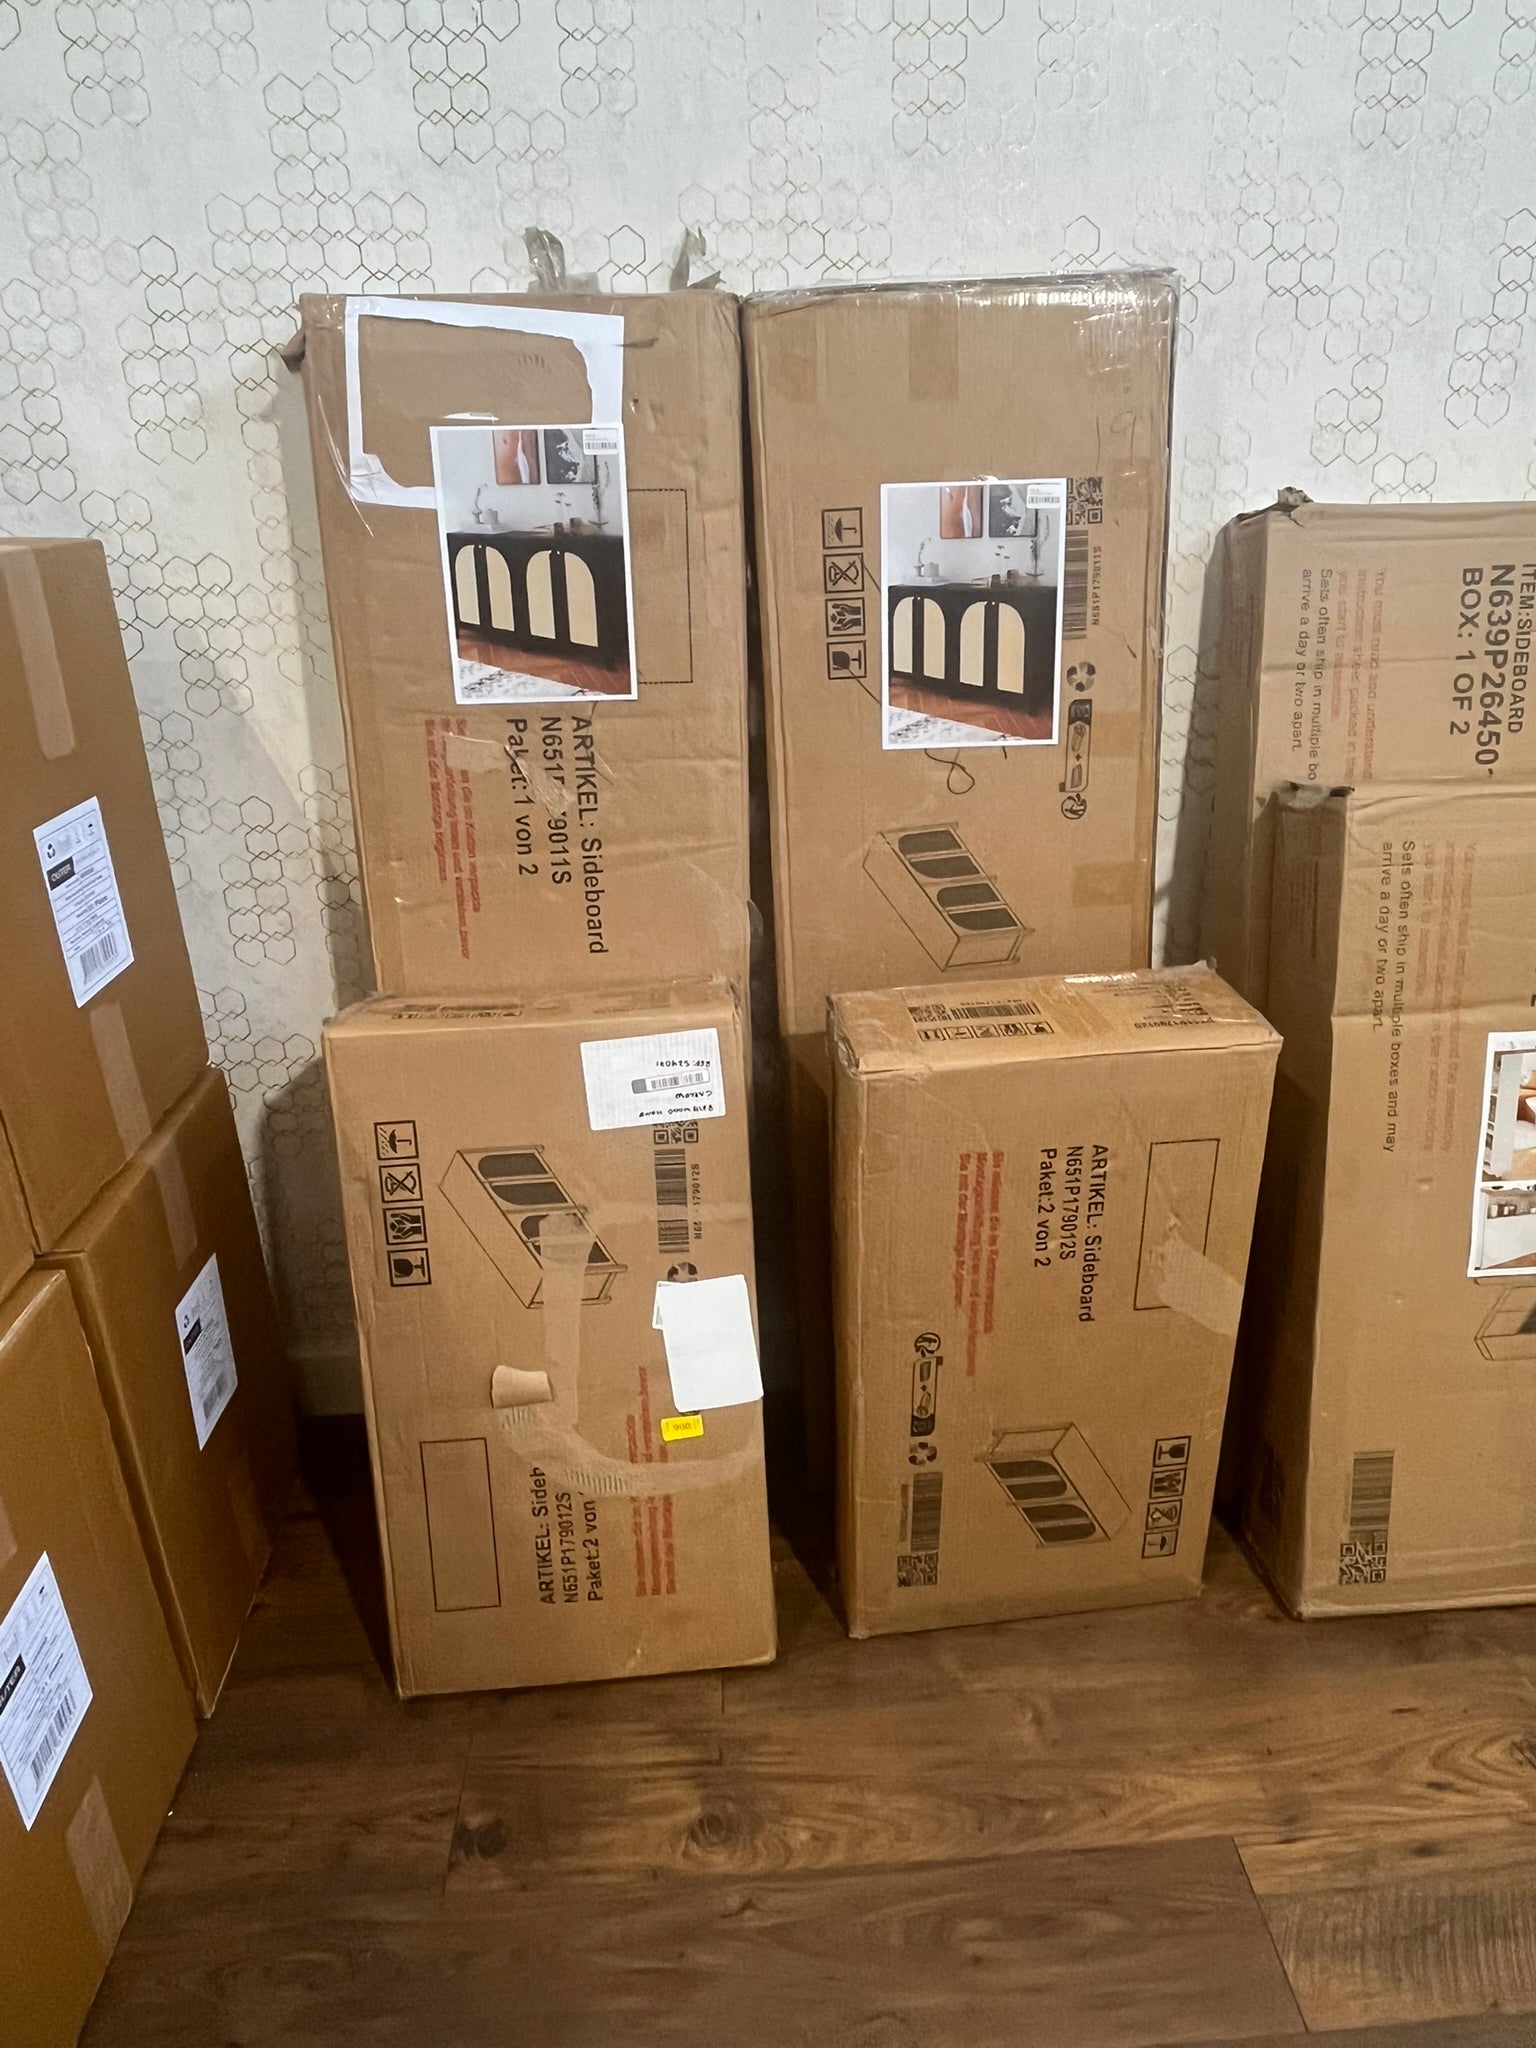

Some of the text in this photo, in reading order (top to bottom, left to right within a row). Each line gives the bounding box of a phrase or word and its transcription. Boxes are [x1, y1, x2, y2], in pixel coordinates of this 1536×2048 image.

[1301, 569, 1313, 611] arrive
[1299, 617, 1309, 625] a
[1317, 607, 1330, 644] often
[1295, 631, 1314, 657] day
[1450, 568, 1483, 735] BOX: 1 OF 2
[1293, 682, 1306, 707] two
[1313, 684, 1324, 697] in
[515, 815, 535, 856] von
[572, 715, 609, 954] ARTIKEL: Sideboard
[519, 864, 539, 876] 2
[1380, 842, 1395, 886] arrive
[1379, 891, 1390, 900] a
[1374, 905, 1392, 933] day
[1376, 938, 1388, 953] or
[1374, 959, 1388, 984] two
[1382, 841, 1416, 1153] Sets often ship in multiple boxes and may
[1034, 1148, 1057, 1267] Paket:2 von 2
[1059, 1146, 1084, 1260] N651P179012S
[1078, 1144, 1109, 1323] ARTIKEL: Sideboard
[583, 1500, 598, 1533] von
[535, 1523, 556, 1604] ARTIKEL:
[555, 1492, 578, 1603] N651P179012S
